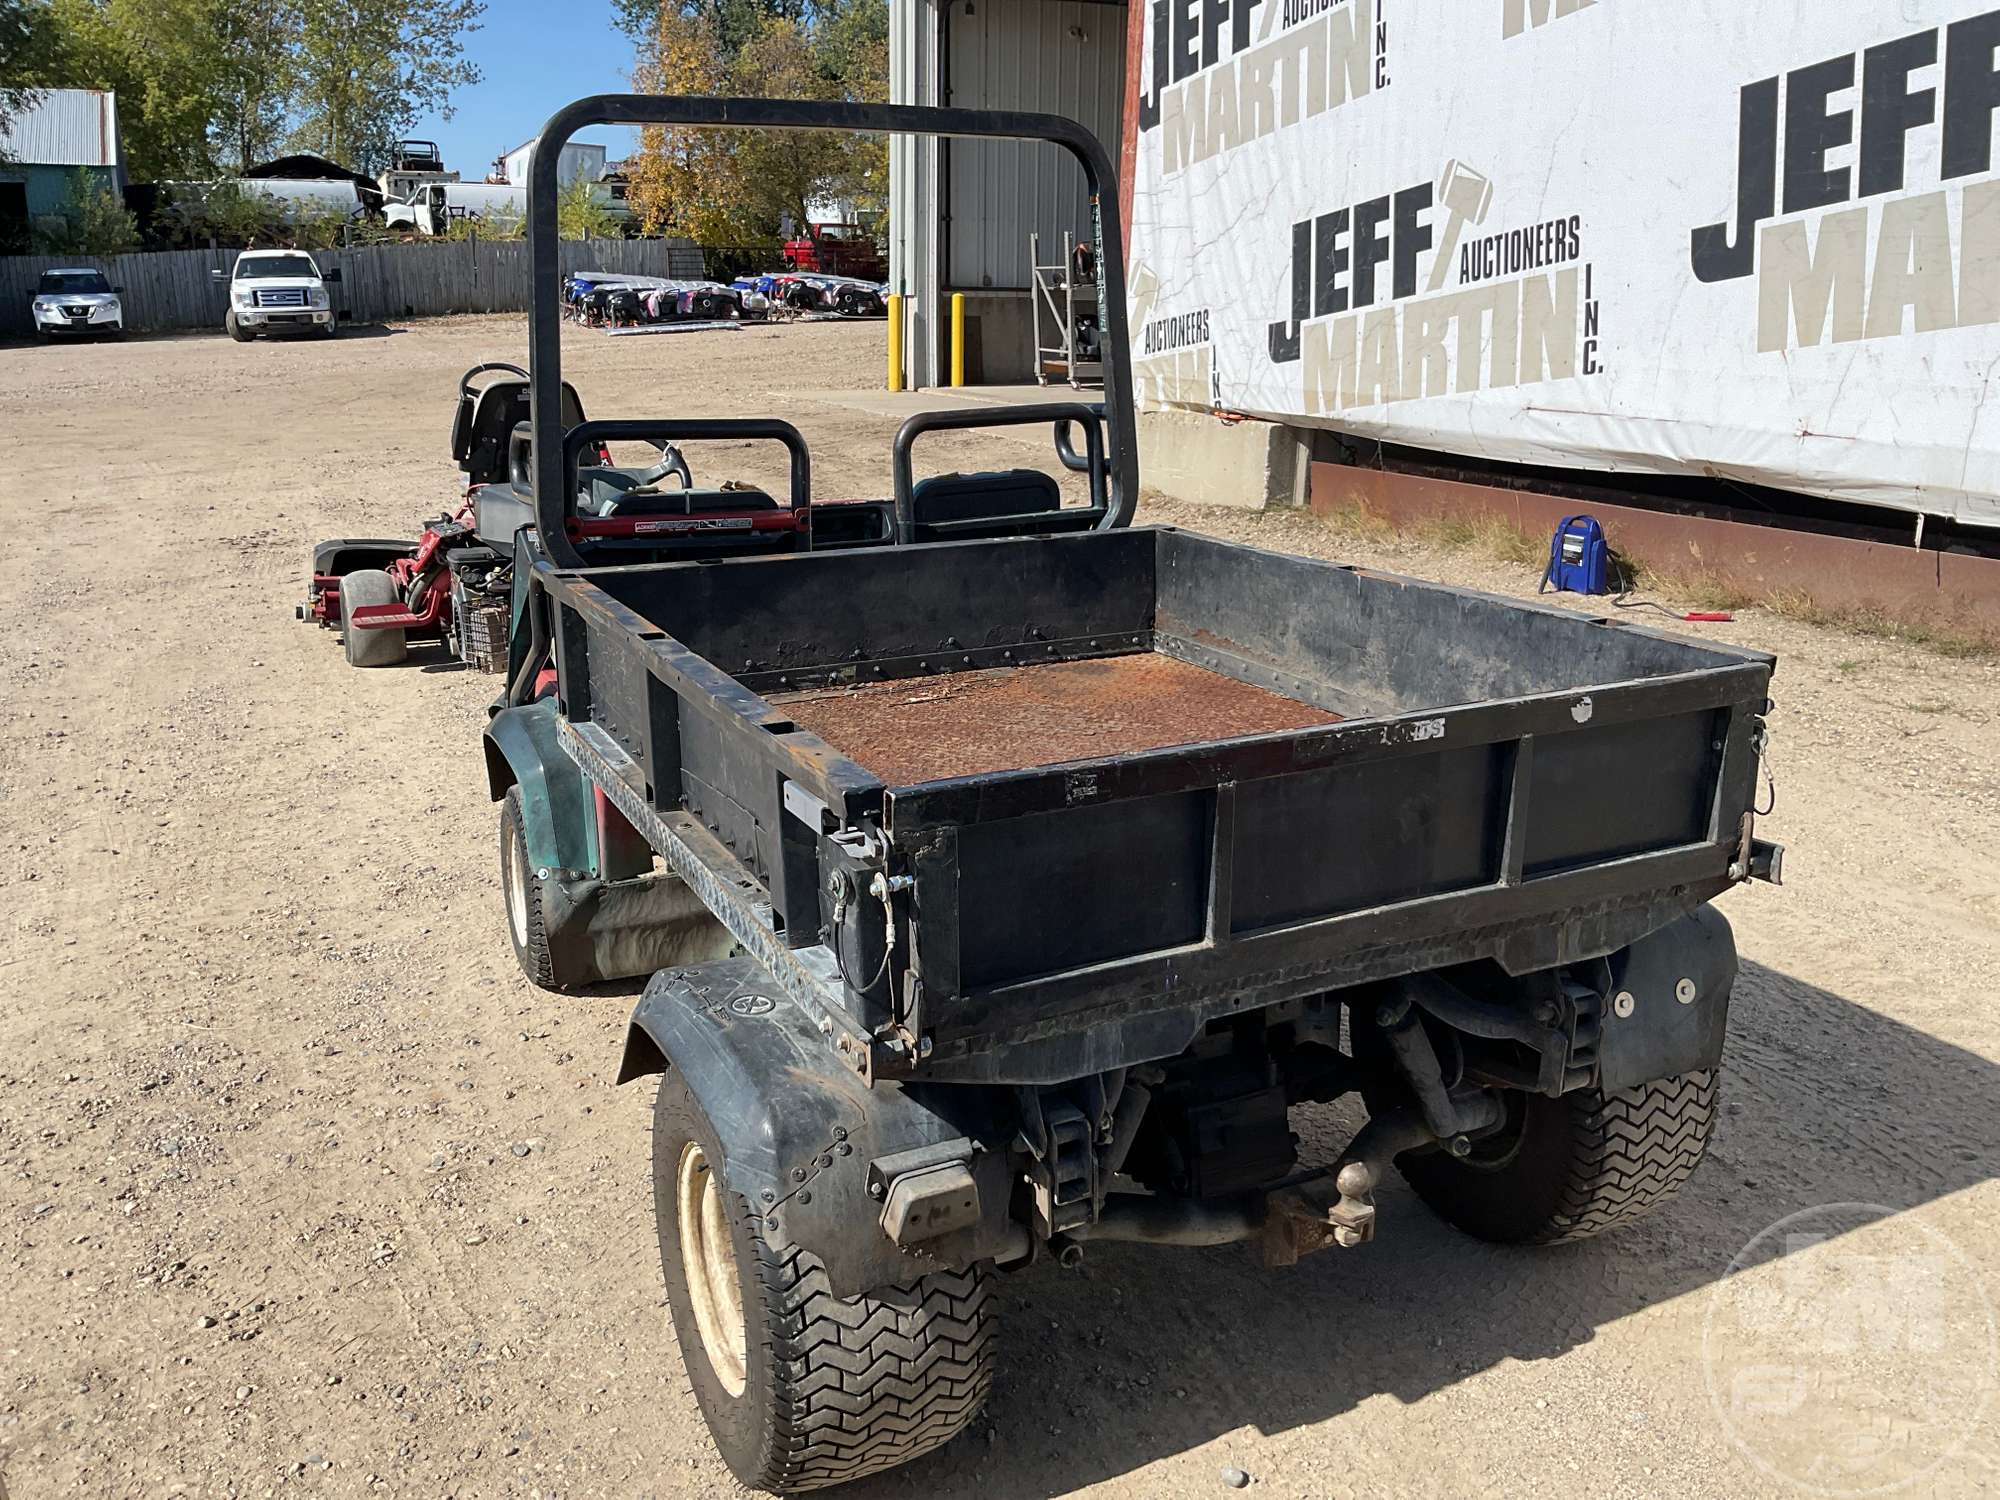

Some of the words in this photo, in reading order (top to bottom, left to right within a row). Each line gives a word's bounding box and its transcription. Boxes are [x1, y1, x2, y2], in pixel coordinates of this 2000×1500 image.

[1162, 0, 1371, 176] MARTIN
[1268, 181, 1434, 364] JEFF
[1459, 214, 1581, 285] AUCTIONEERS
[1144, 308, 1210, 355] AUCTIONEERS
[1302, 267, 1579, 415] MARTIN
